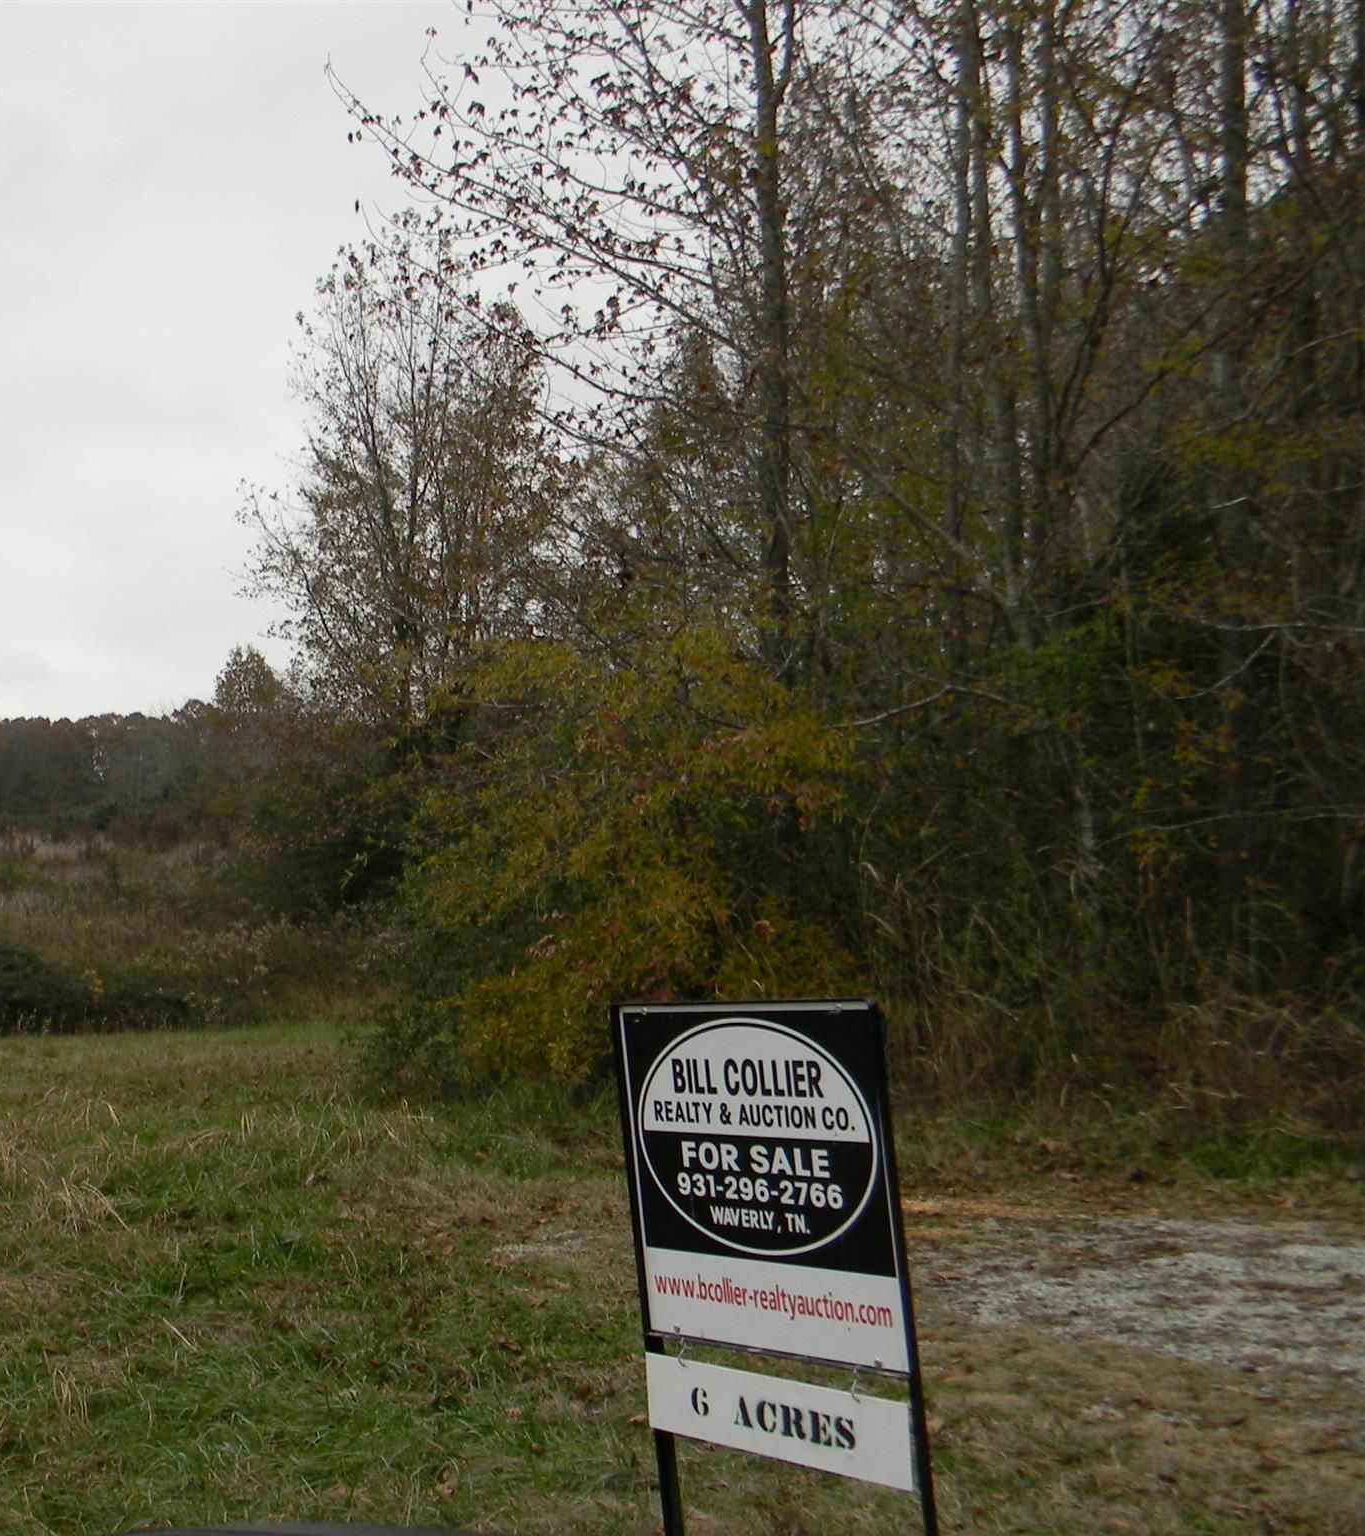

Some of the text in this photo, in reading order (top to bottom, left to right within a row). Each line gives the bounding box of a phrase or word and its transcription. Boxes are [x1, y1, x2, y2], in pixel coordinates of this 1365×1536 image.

[671, 1058, 824, 1098] BILL COLLIER
[653, 1100, 855, 1131] REALTY & AUCTION CO.
[681, 1140, 831, 1178] FOR SALE
[677, 1172, 843, 1209] 931-296-2766
[784, 1213, 811, 1235] TN.
[654, 1273, 893, 1328] www.bcollier-realtyauction.com
[691, 1387, 857, 1451] 6 ACRES
